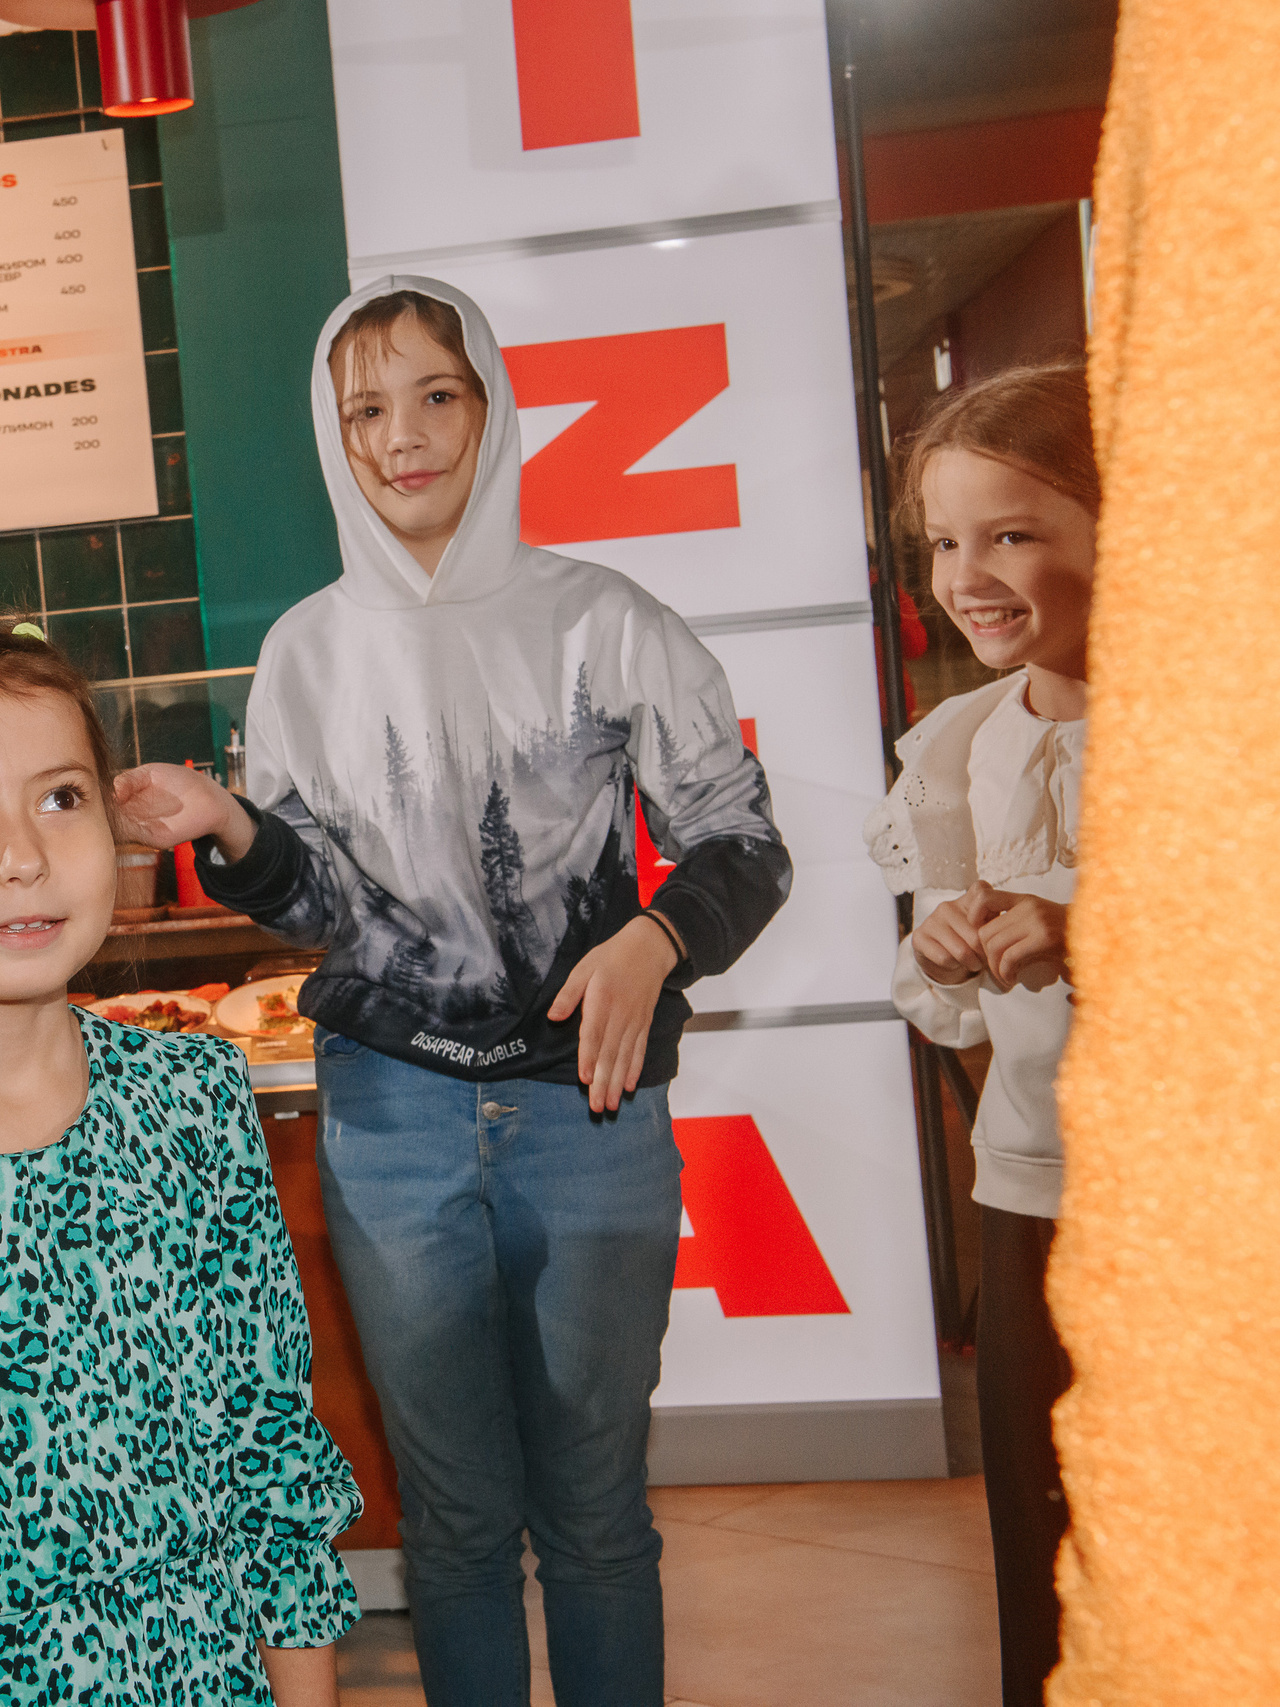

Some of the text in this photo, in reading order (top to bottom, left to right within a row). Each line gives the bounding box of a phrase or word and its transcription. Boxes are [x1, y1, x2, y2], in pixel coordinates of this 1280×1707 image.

[52, 196, 78, 208] 450
[54, 229, 81, 241] 400
[56, 254, 83, 265] 400
[60, 284, 86, 295] 450
[72, 415, 98, 427] 200
[74, 439, 100, 450] 200
[410, 1031, 475, 1067] DISAPPEAR
